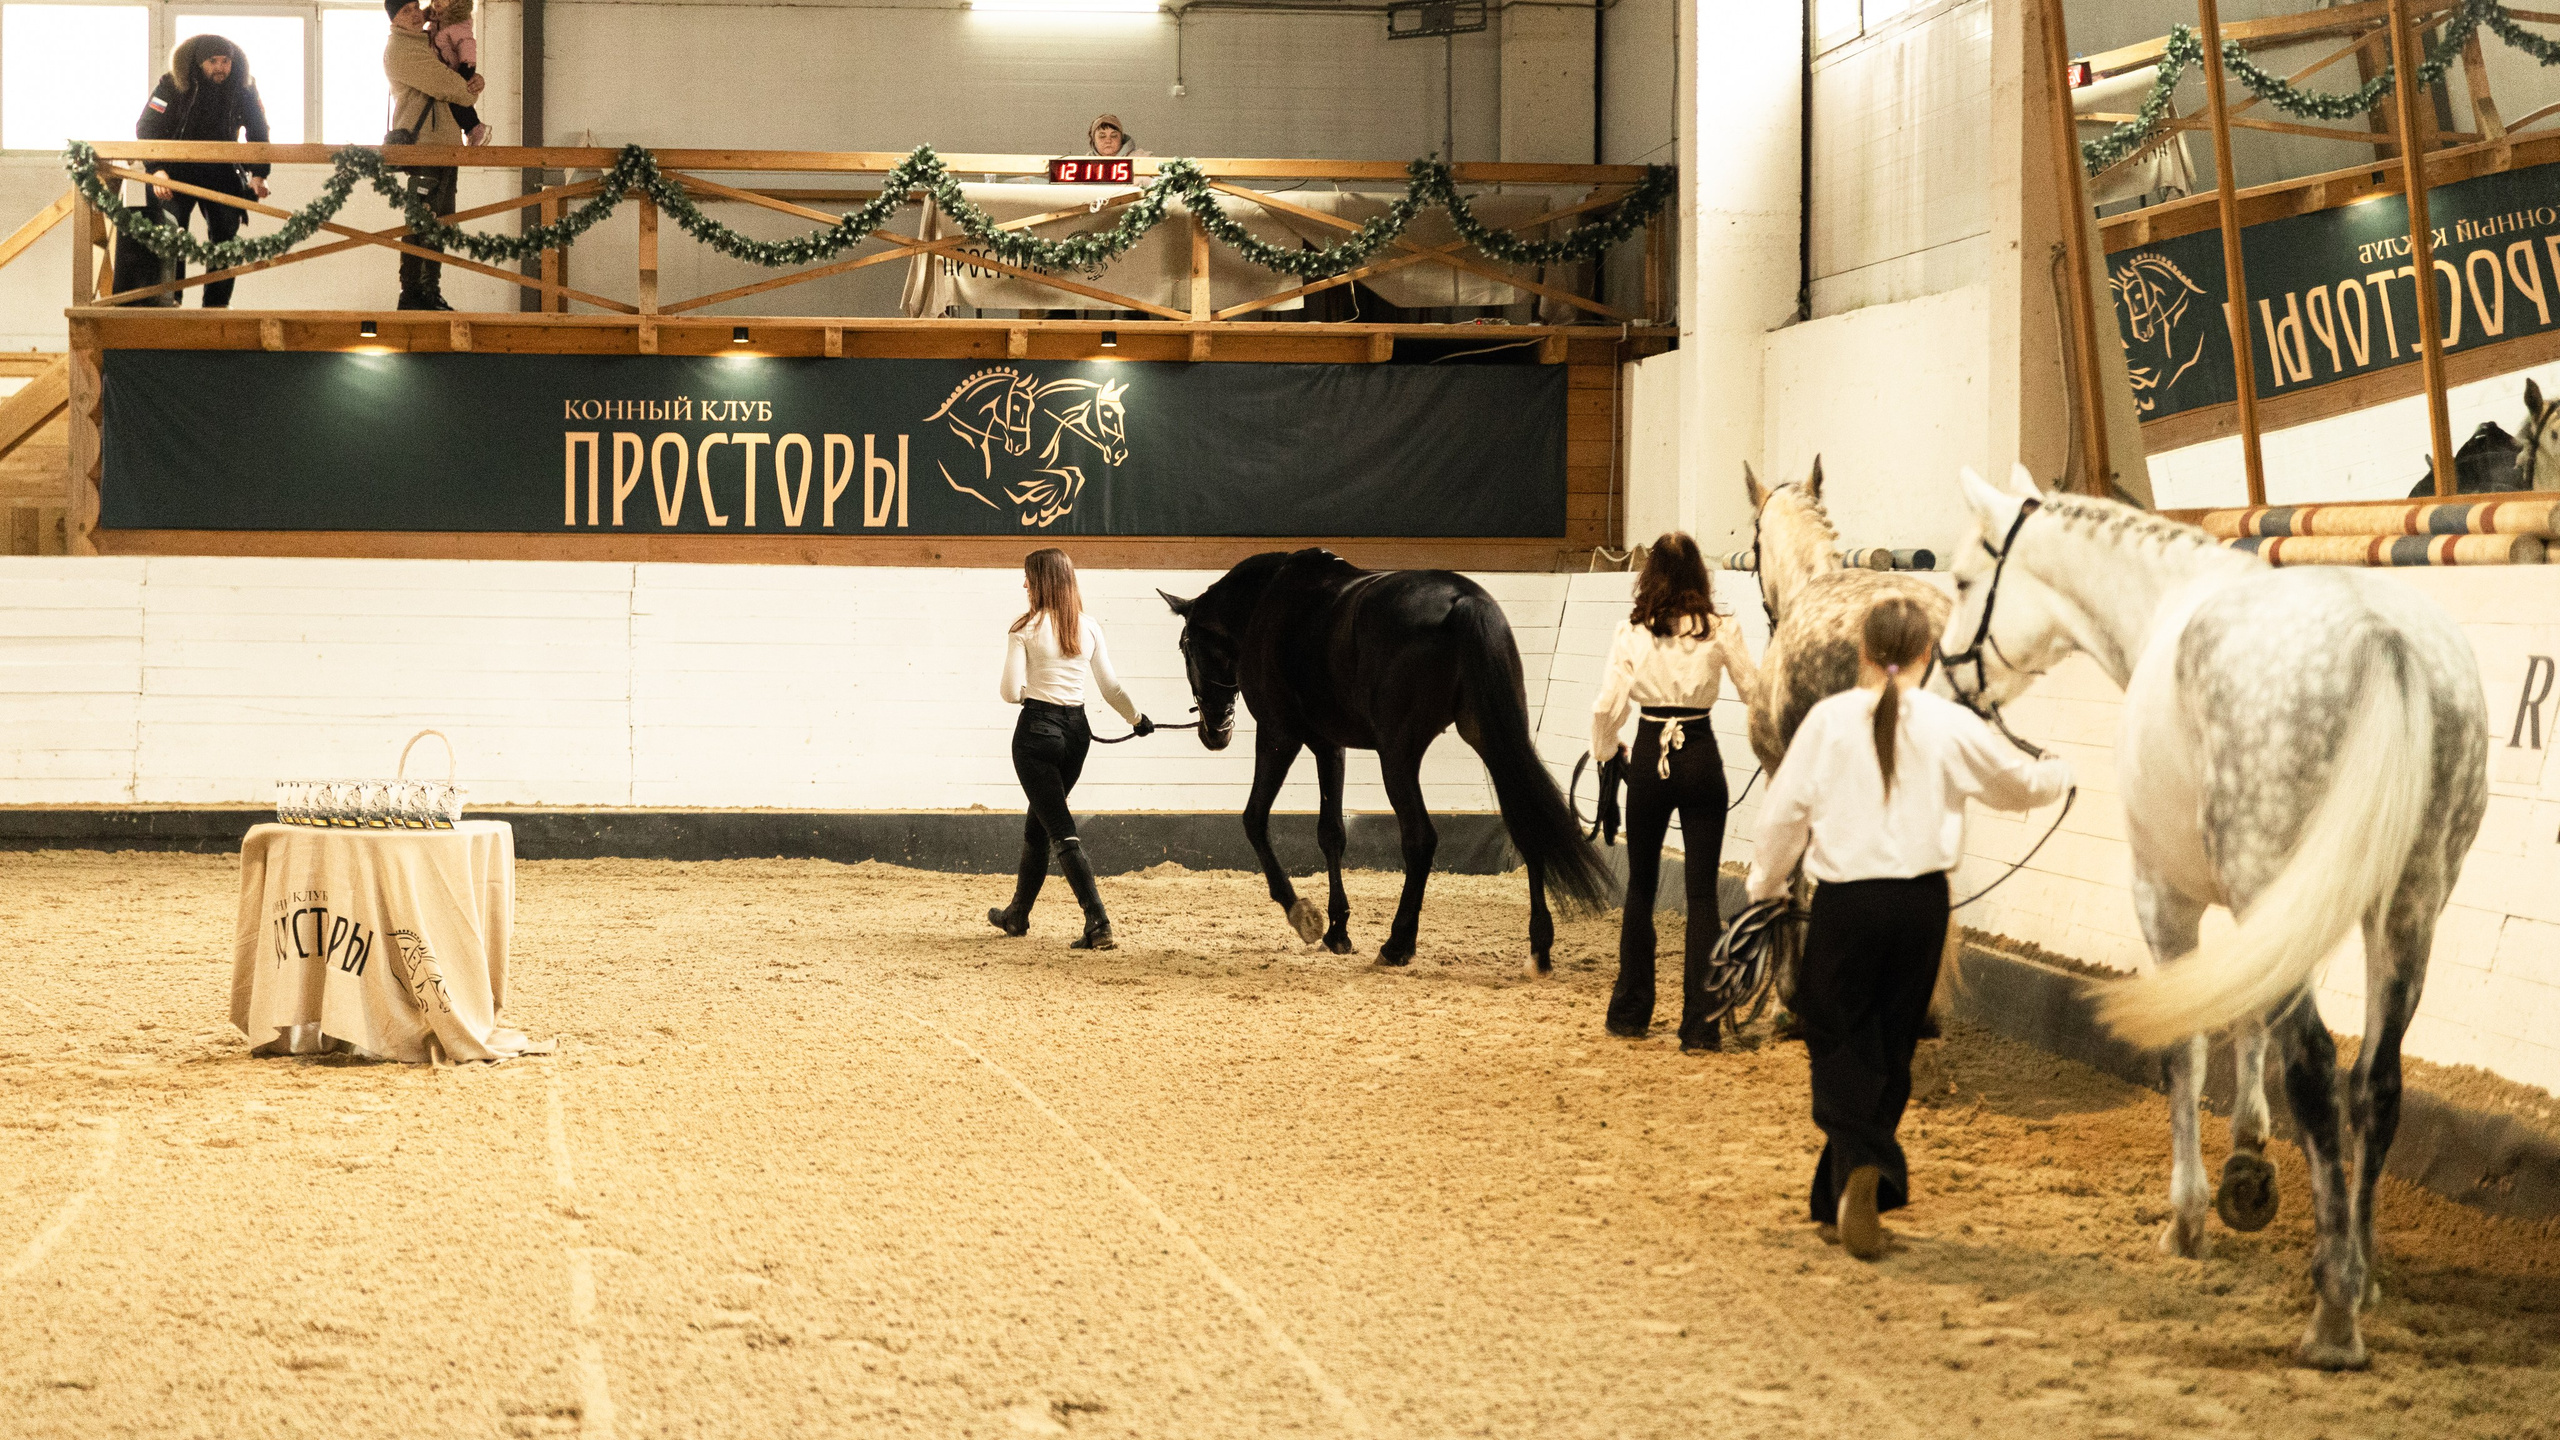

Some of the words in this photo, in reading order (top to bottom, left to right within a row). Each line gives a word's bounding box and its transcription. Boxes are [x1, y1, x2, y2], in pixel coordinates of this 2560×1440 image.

[1060, 162, 1077, 181] 12
[1085, 163, 1104, 180] 11
[1111, 162, 1129, 181] 15
[565, 396, 692, 420] КОННЫЙ
[701, 401, 773, 421] КЛУБ
[565, 432, 909, 527] ПРОСТОРЫ
[2507, 655, 2555, 750] R
[293, 890, 328, 902] КЛУБ
